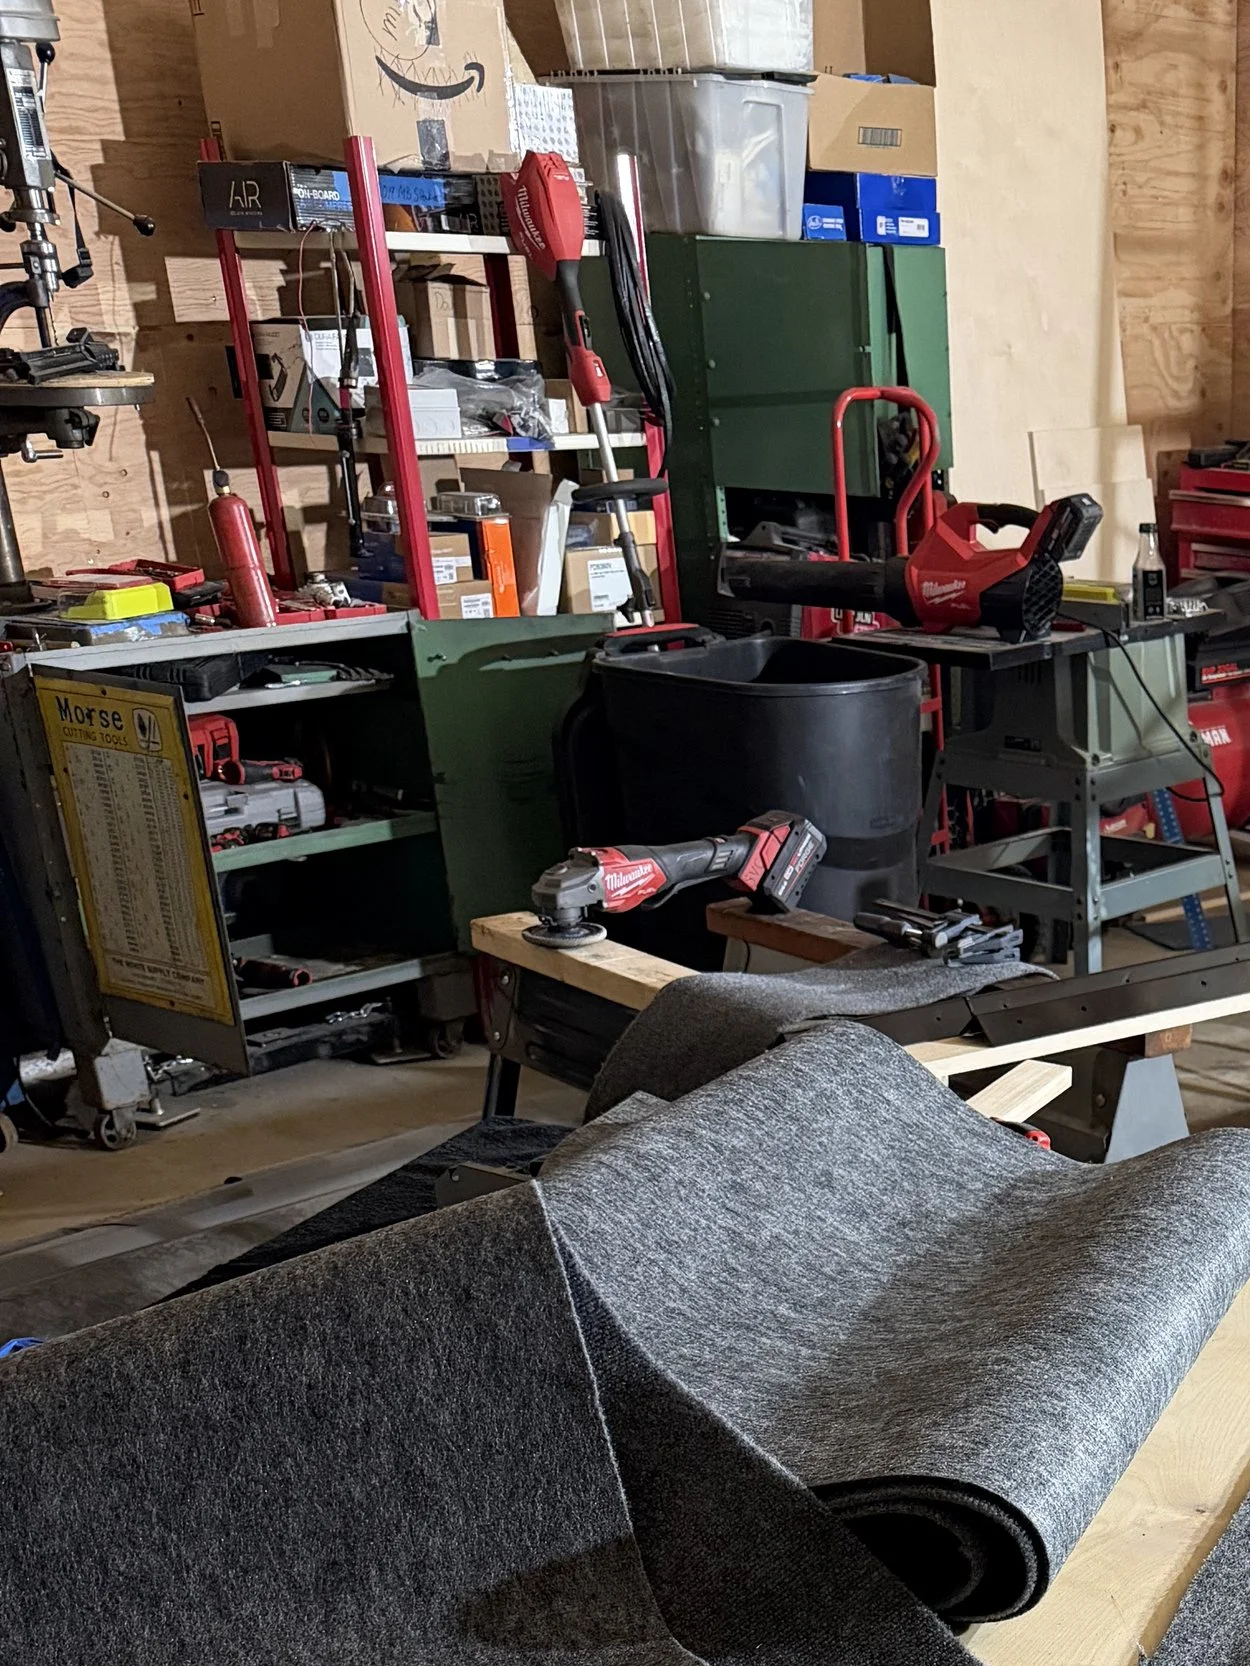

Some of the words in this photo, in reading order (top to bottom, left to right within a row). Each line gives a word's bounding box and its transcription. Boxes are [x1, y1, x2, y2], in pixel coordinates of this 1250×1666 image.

[298, 188, 340, 201] ON-BOARD
[516, 185, 546, 251] Milwaukee
[55, 695, 124, 731] Morse
[62, 726, 97, 741] CUTTING
[100, 732, 129, 746] TOOLS
[604, 863, 654, 892] Milwaukee
